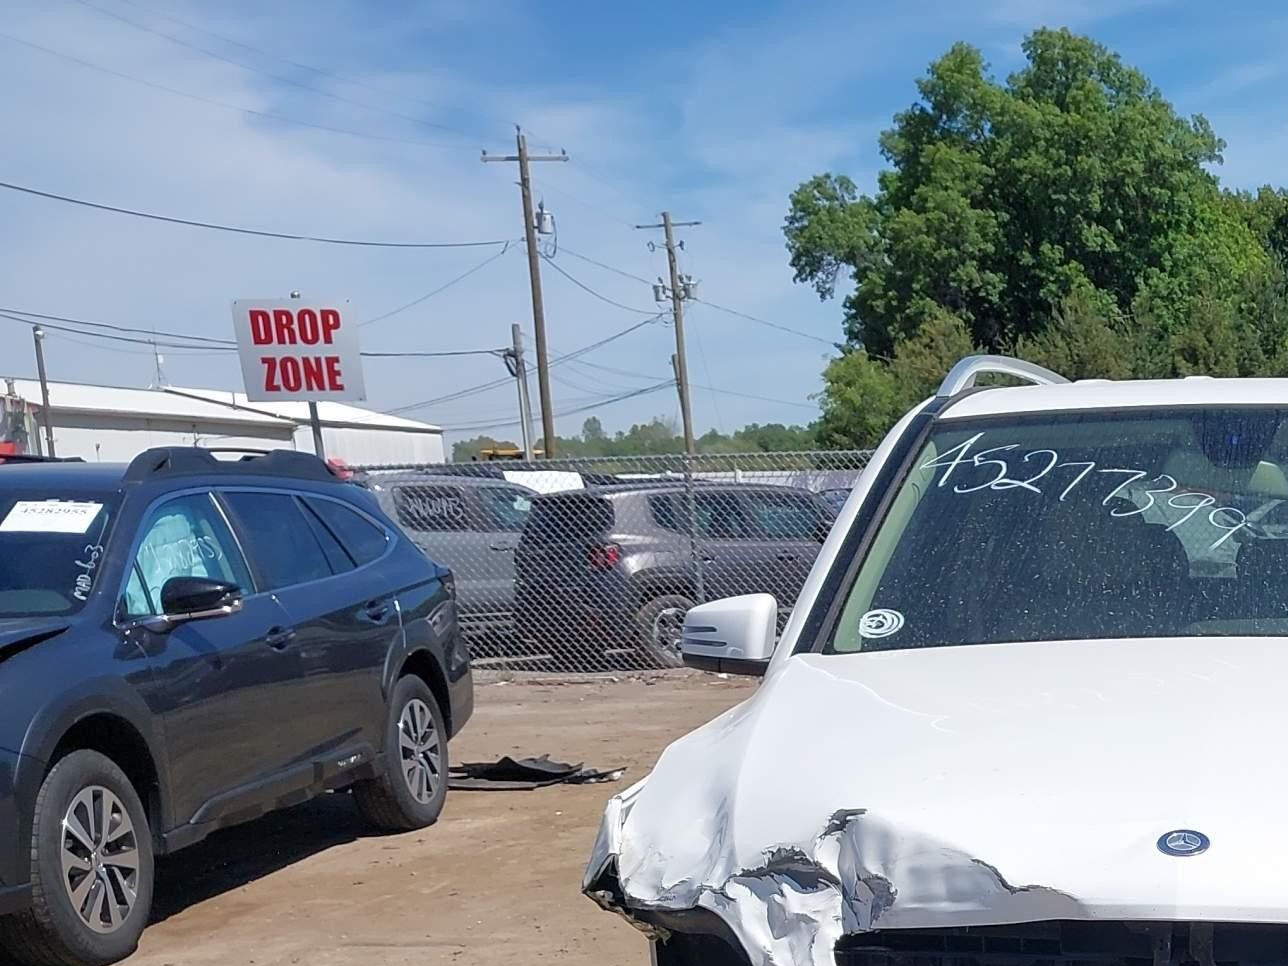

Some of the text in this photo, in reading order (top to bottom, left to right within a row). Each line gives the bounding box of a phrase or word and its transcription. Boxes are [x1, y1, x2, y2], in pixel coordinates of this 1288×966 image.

[249, 308, 341, 346] DROP
[260, 356, 345, 392] ZONE
[919, 432, 1247, 550] 45277399
